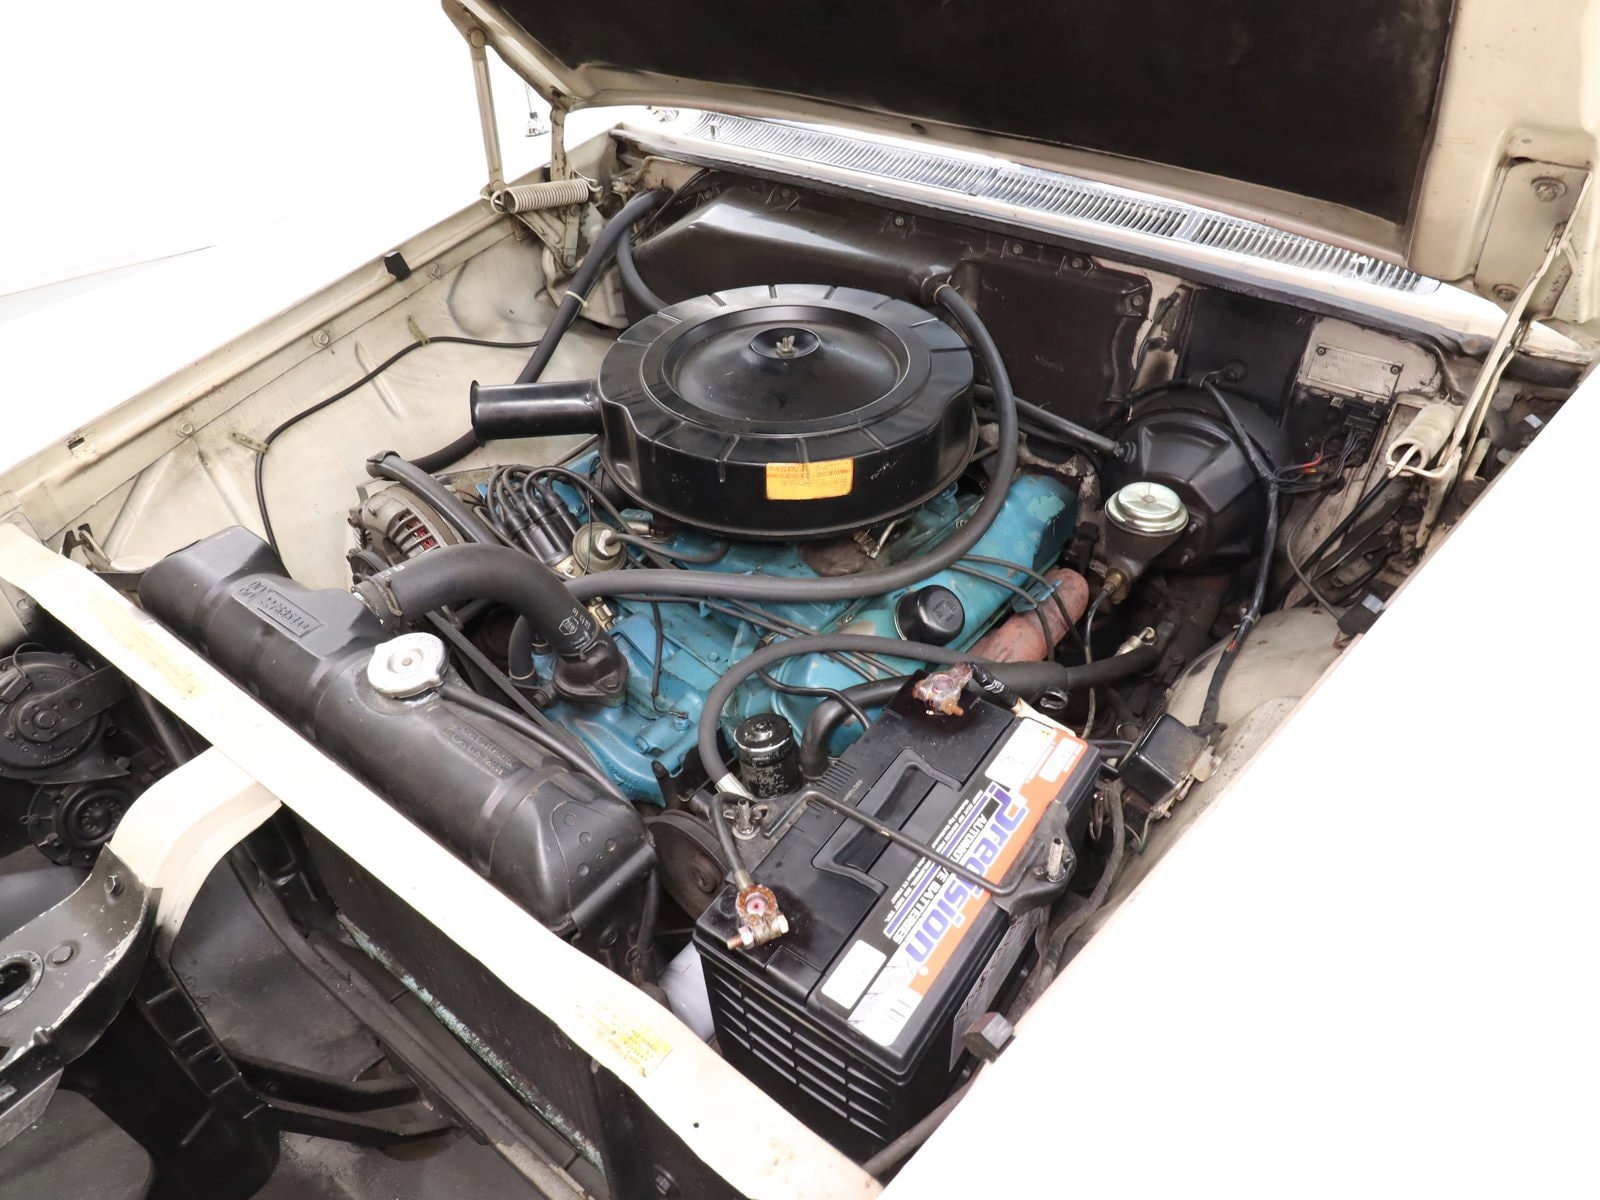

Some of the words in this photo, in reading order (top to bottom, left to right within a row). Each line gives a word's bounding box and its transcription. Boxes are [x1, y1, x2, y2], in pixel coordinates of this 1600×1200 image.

[906, 784, 1026, 962] Precision
[936, 812, 987, 882] AUTOMOTVE
[891, 880, 940, 944] BATTERIES
